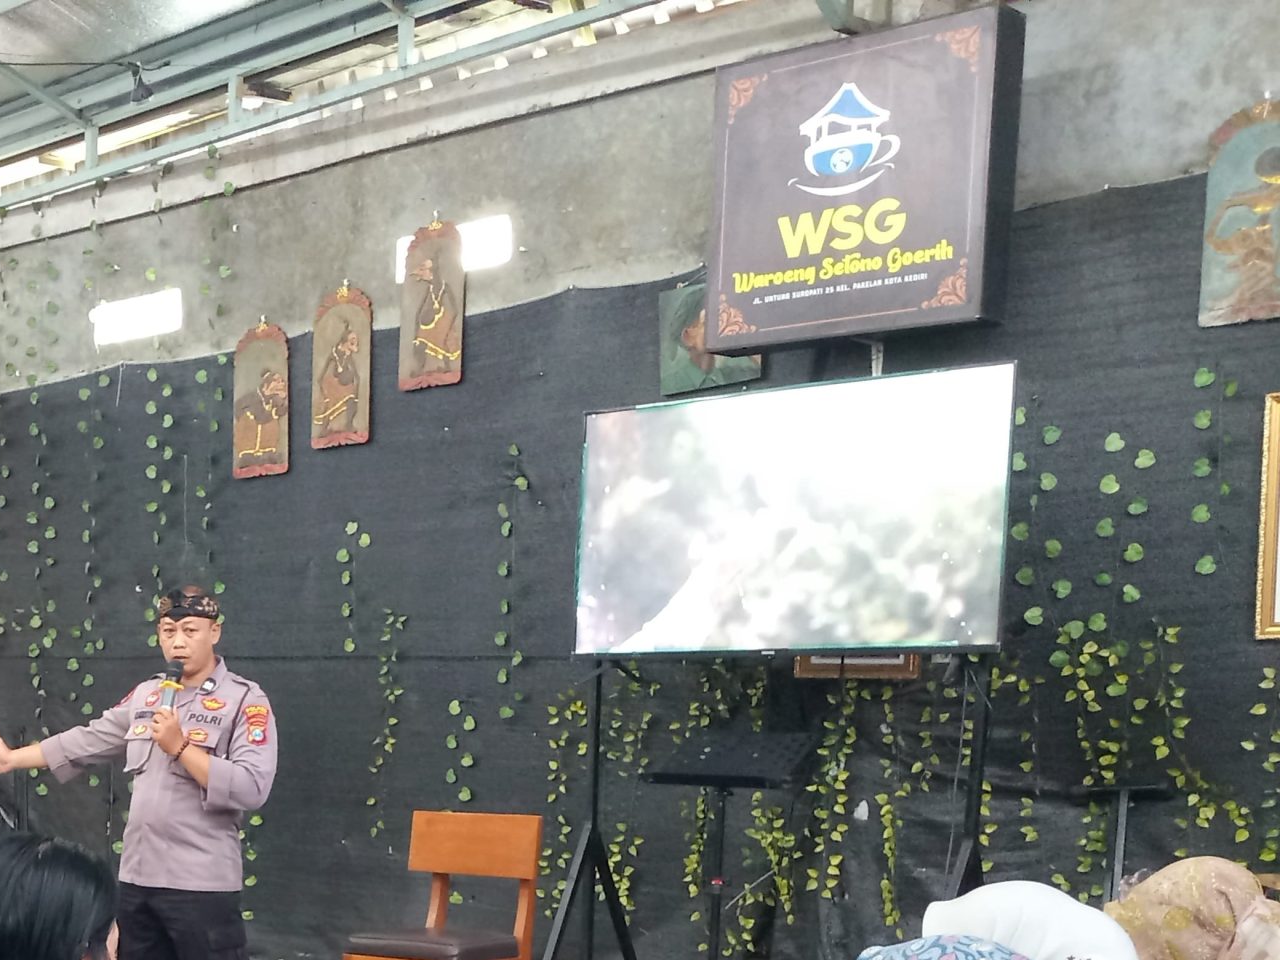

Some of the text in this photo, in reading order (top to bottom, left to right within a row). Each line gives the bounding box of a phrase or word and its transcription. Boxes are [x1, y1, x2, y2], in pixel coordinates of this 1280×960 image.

[777, 197, 907, 258] WSG
[732, 239, 954, 293] Waroeng Setono Goerih
[791, 287, 824, 299] SUROPATI
[884, 275, 903, 285] KOTA
[903, 272, 929, 282] KEDIRI
[187, 713, 223, 726] POLRI
